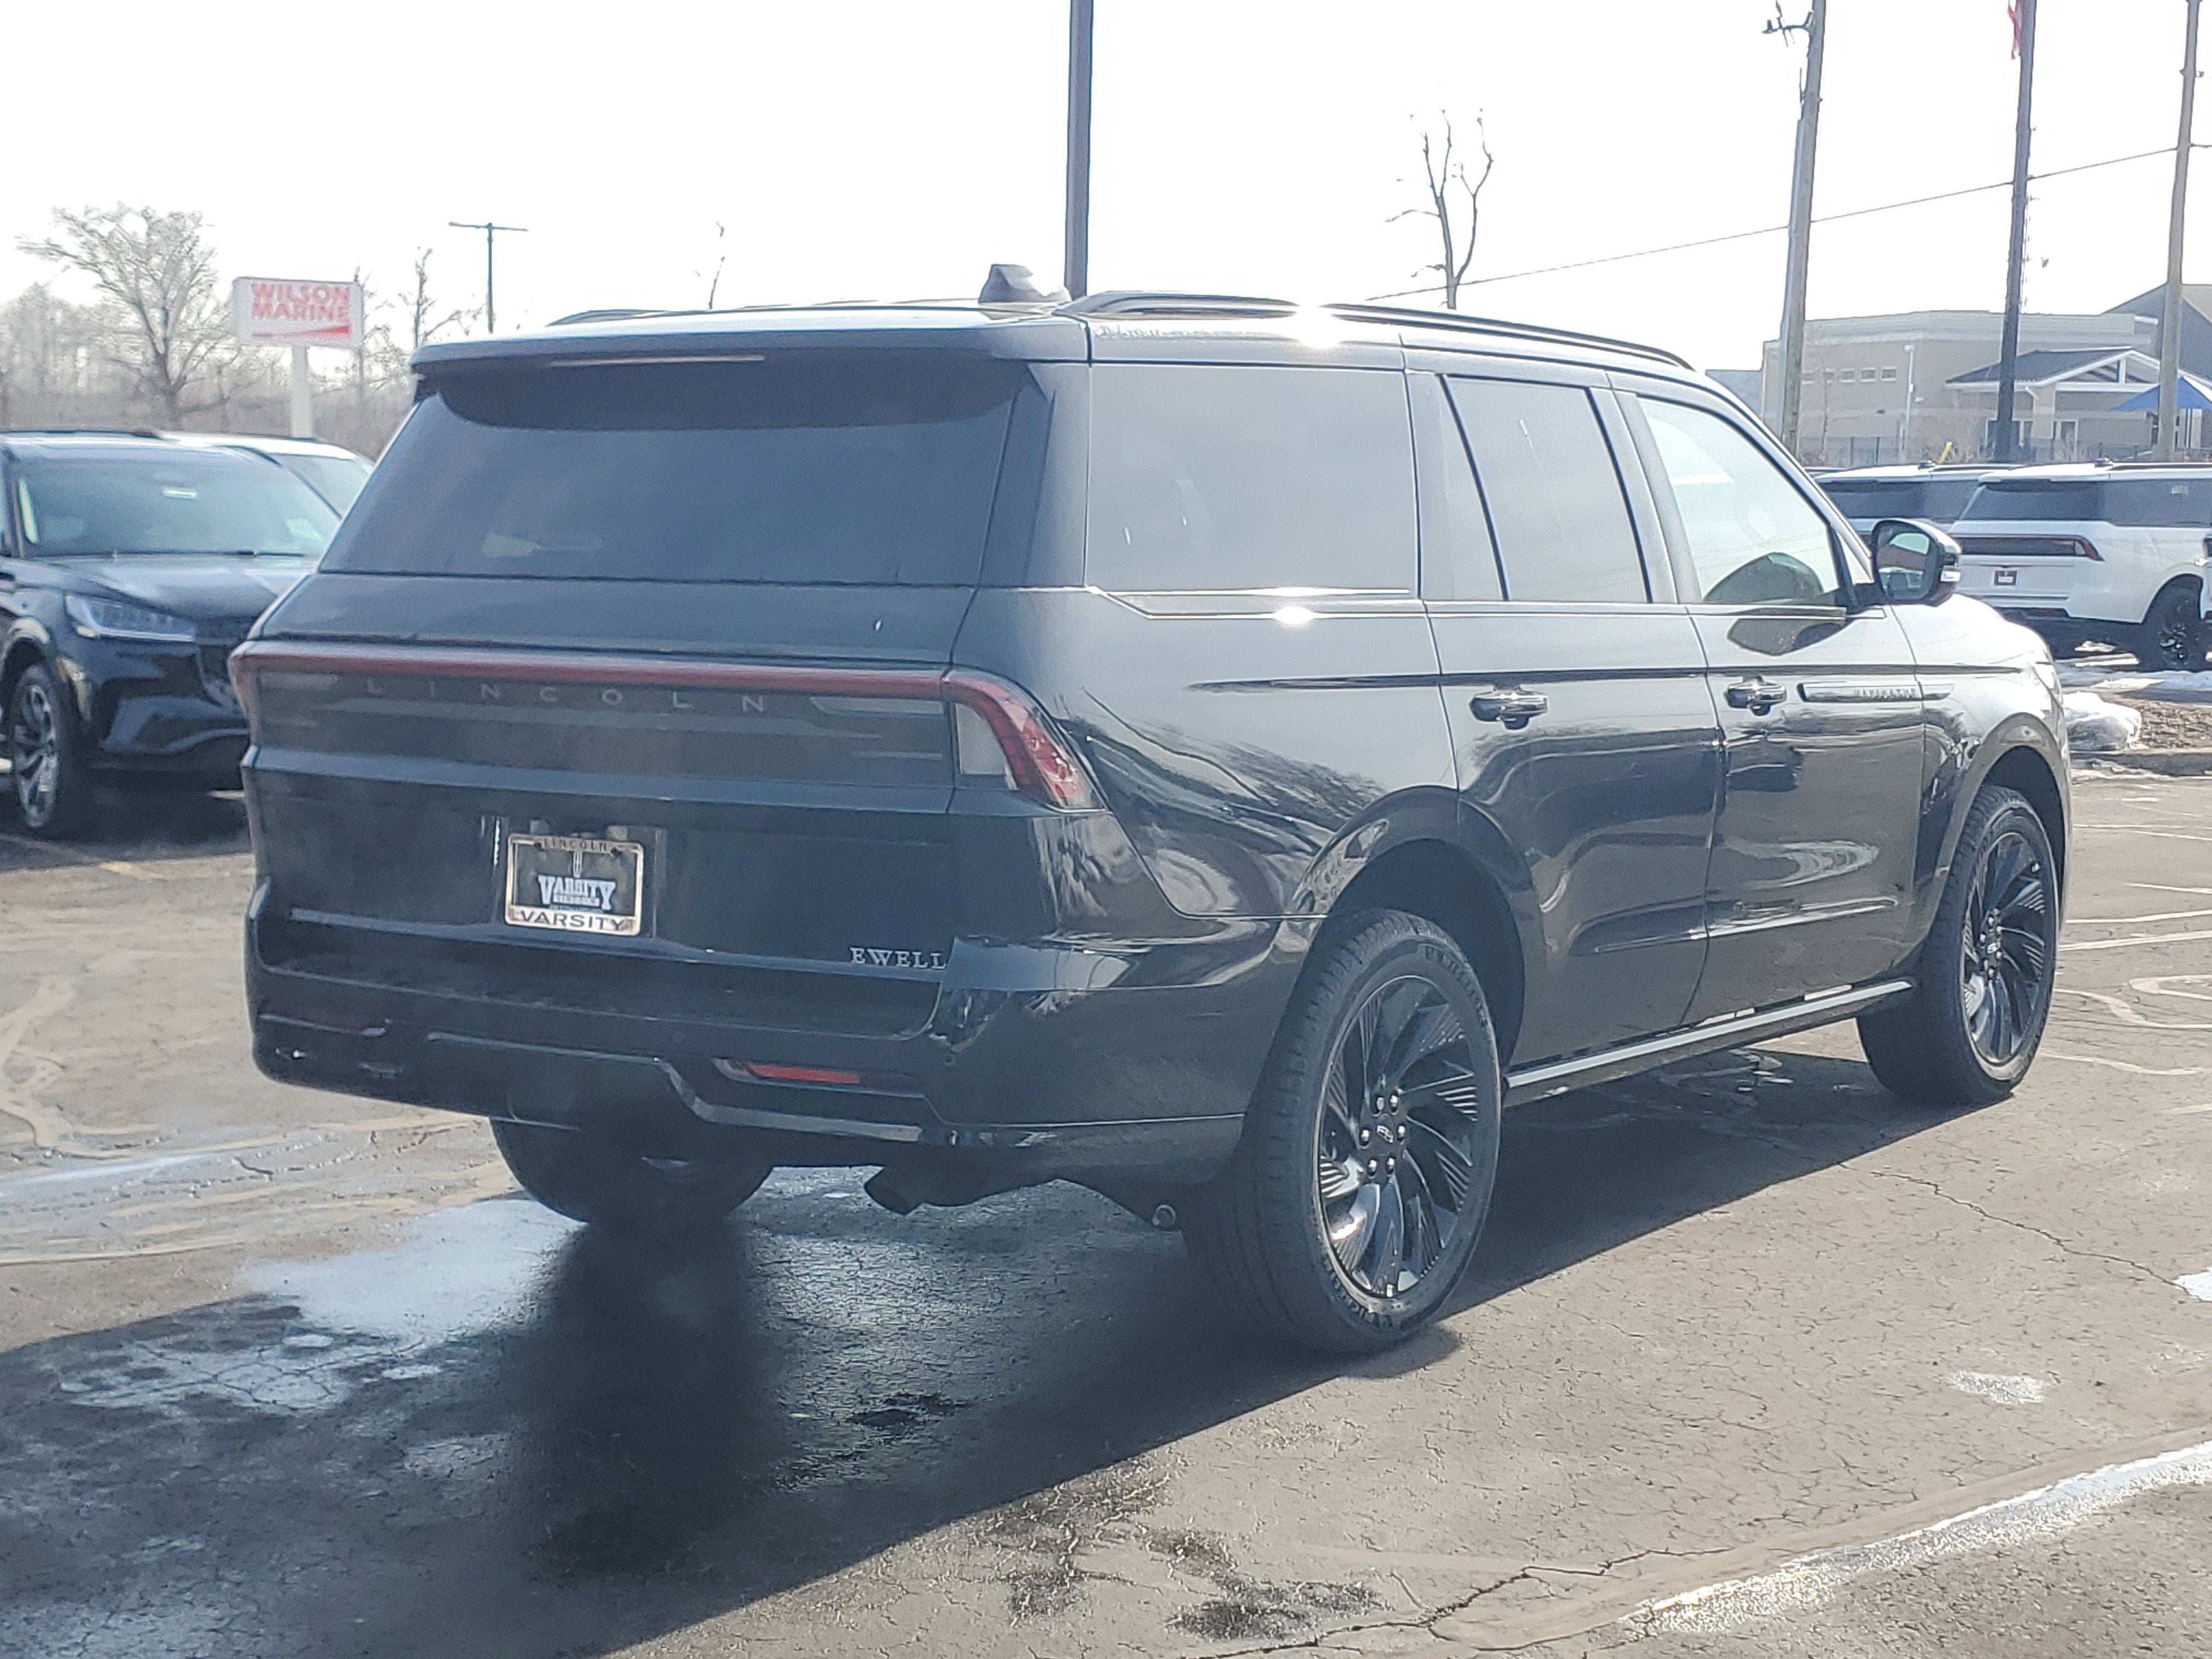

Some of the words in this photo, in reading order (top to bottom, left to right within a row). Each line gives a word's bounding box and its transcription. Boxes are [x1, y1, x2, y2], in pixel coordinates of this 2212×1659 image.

[251, 283, 349, 303] WILSON
[252, 301, 349, 321] MARINE
[366, 679, 764, 712] LINCOLN
[544, 838, 607, 850] LINCOLN
[538, 874, 616, 910] VARSITY
[521, 910, 625, 930] VARSITY
[850, 947, 947, 969] EWELL
